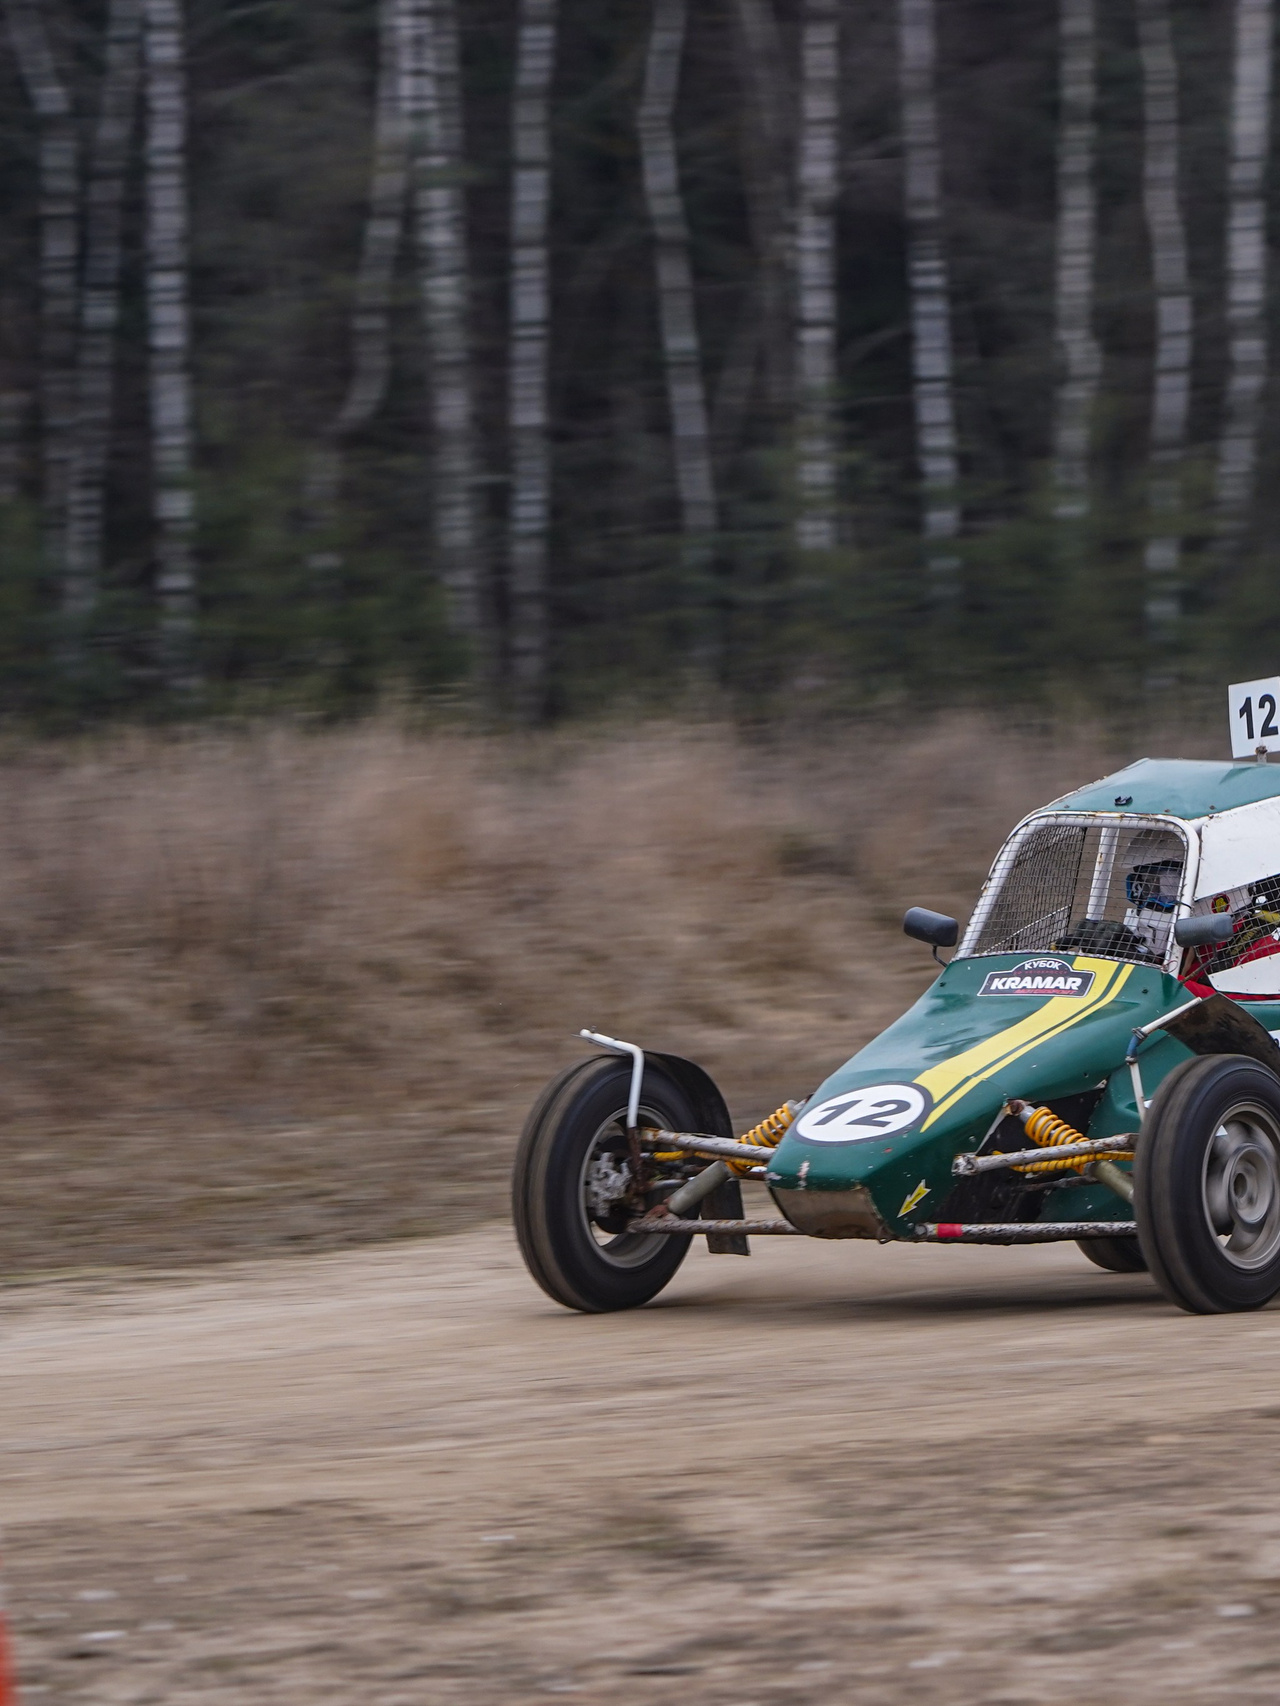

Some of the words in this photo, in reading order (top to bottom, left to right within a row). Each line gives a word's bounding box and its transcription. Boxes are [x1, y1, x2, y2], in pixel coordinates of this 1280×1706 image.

[1239, 694, 1279, 739] 12
[1024, 961, 1063, 970] КУБОК
[990, 976, 1082, 991] KRAMAR
[812, 1098, 912, 1128] 12
